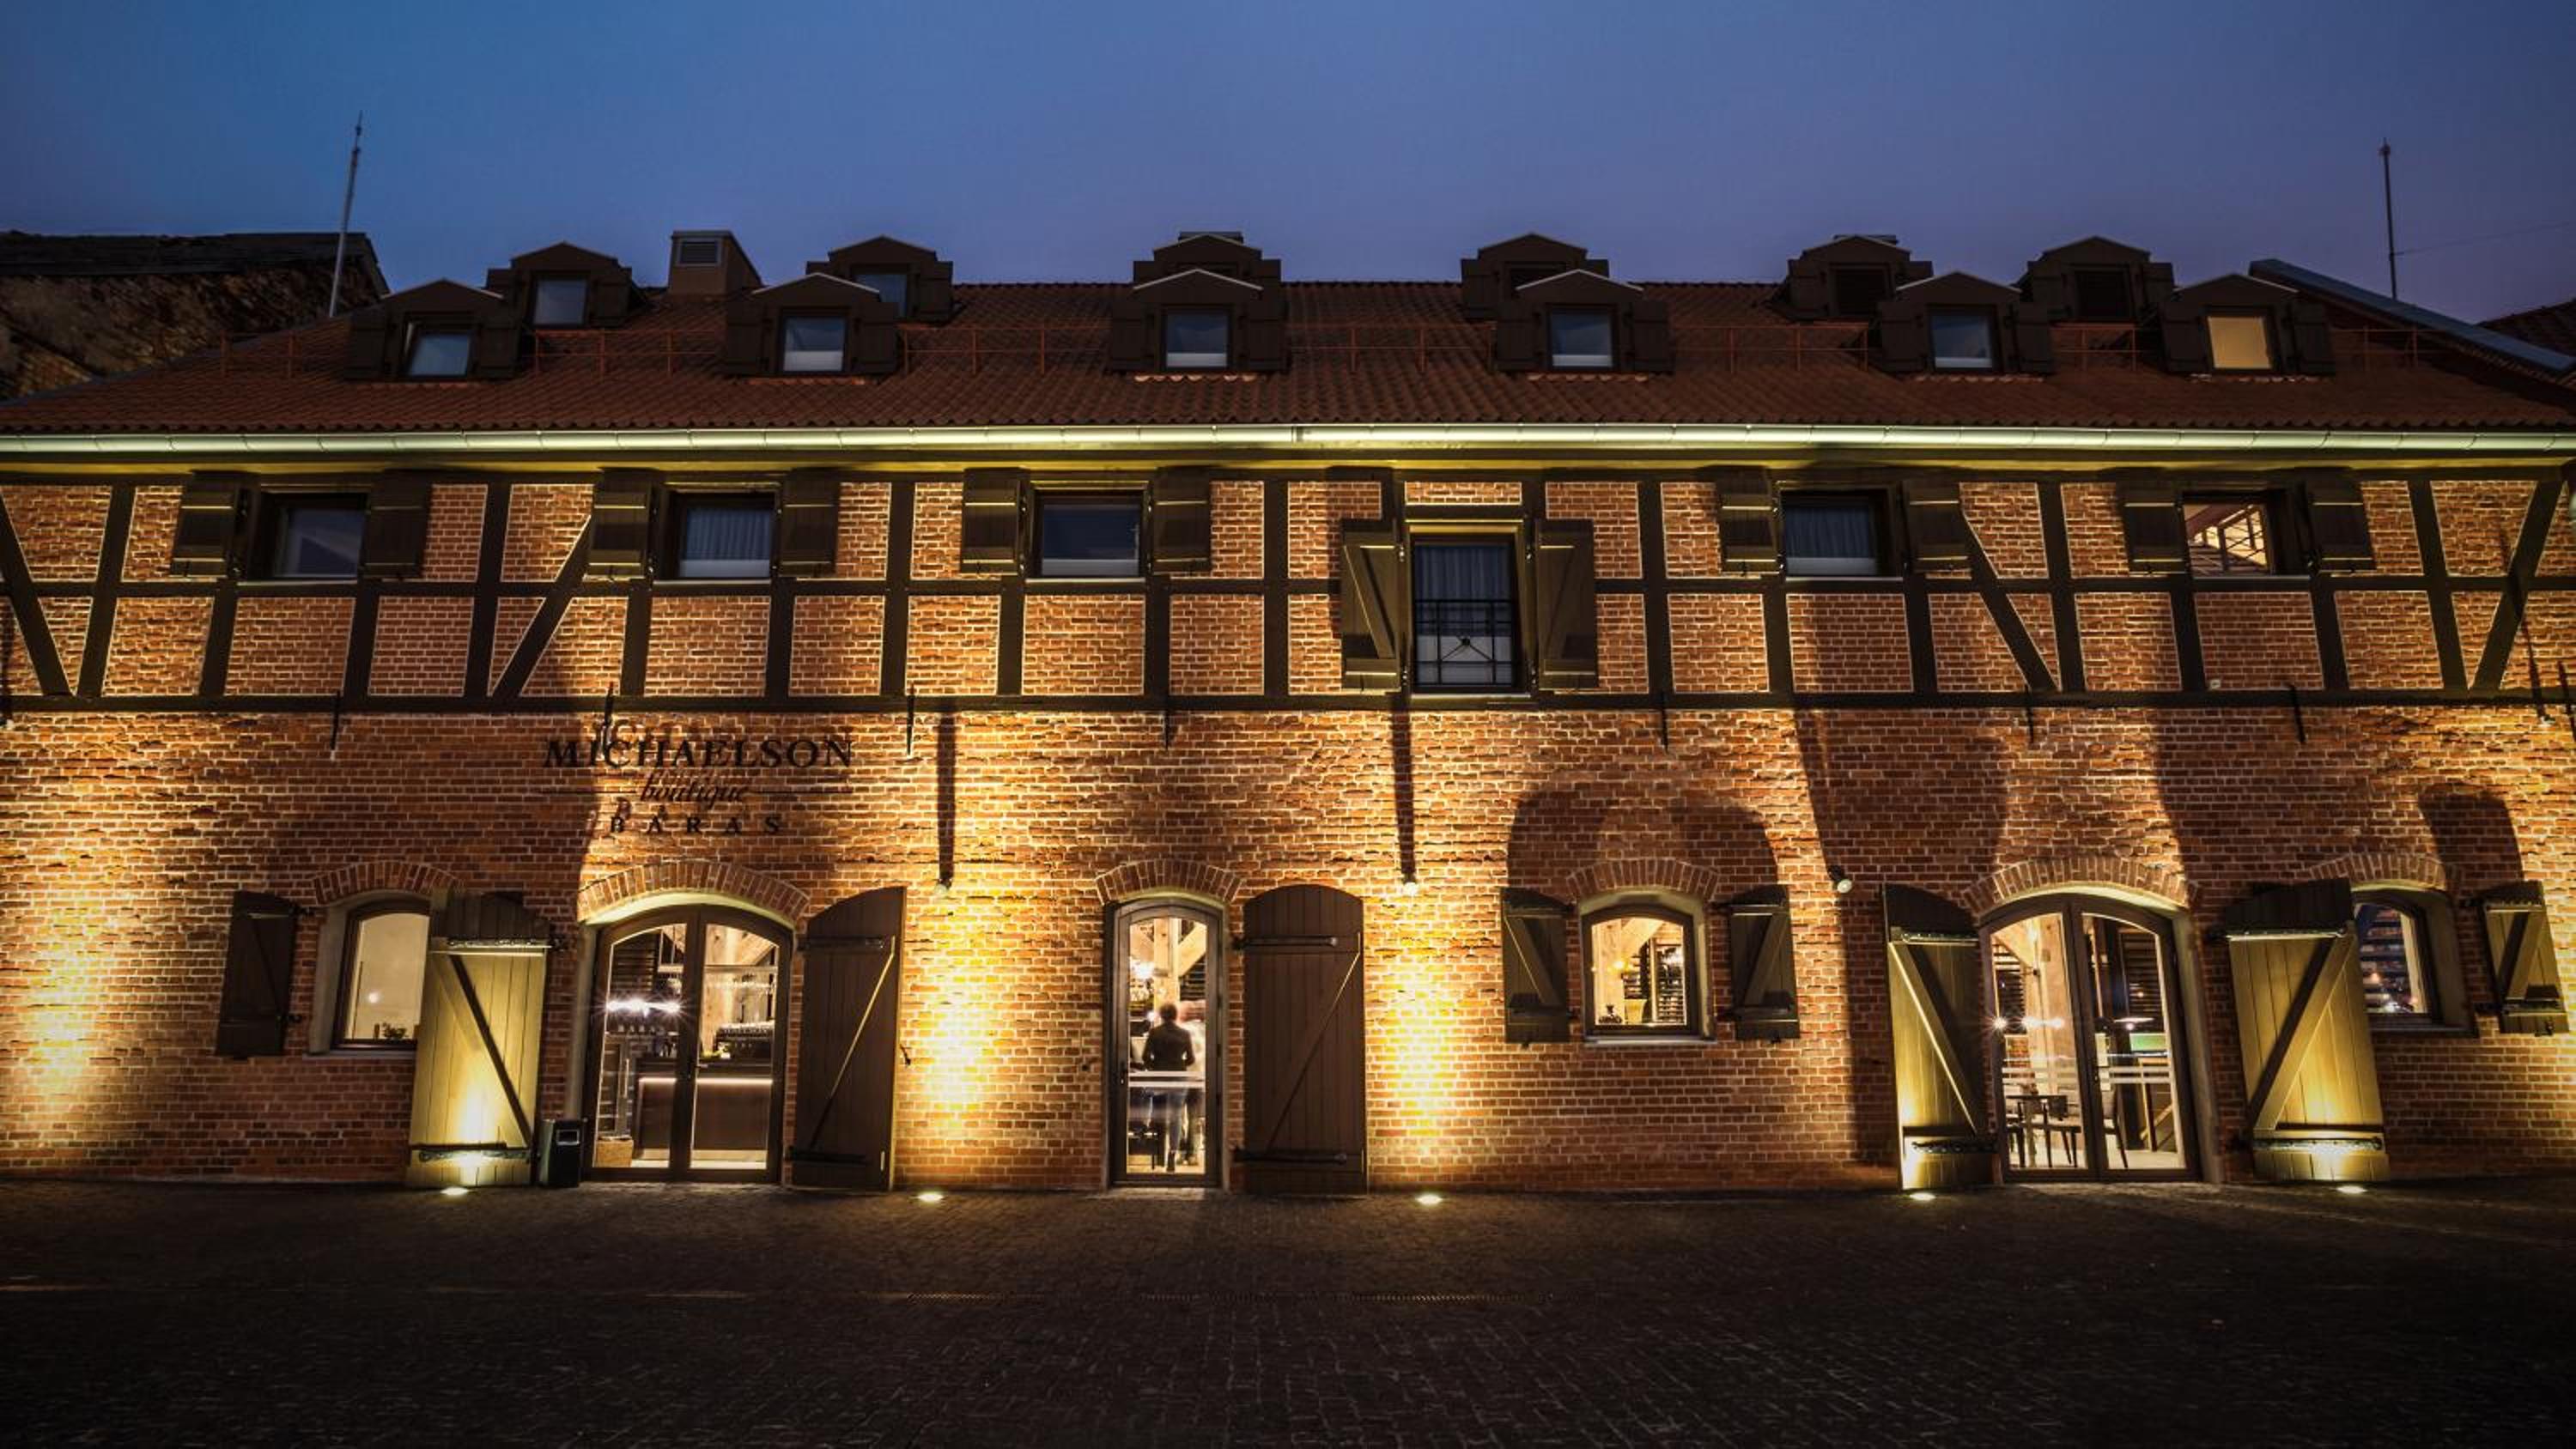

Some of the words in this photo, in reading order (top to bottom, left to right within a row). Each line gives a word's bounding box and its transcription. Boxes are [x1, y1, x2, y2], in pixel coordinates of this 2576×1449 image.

[544, 739, 854, 768] MICHAELSON
[640, 773, 747, 809] boutique
[610, 816, 783, 834] BARAS
